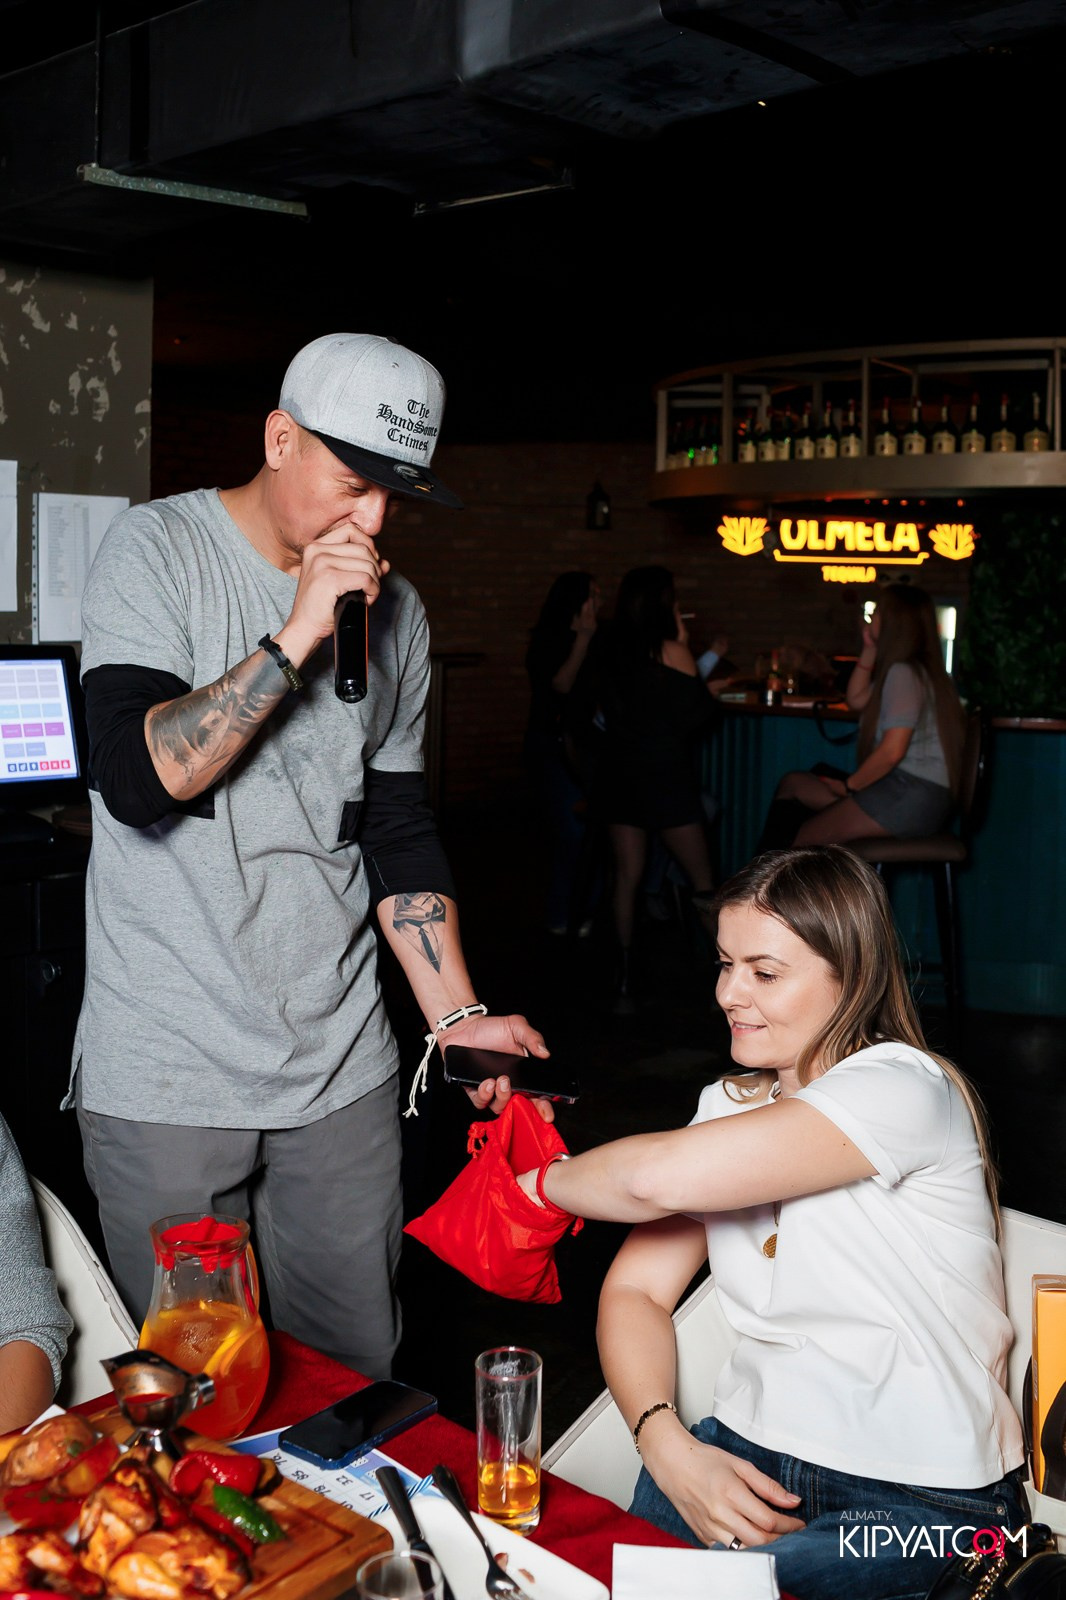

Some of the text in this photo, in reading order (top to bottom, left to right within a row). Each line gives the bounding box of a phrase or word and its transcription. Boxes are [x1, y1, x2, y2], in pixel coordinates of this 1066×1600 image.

[407, 399, 430, 419] The
[387, 428, 429, 451] Crimes
[336, 1475, 375, 1500] 17 32
